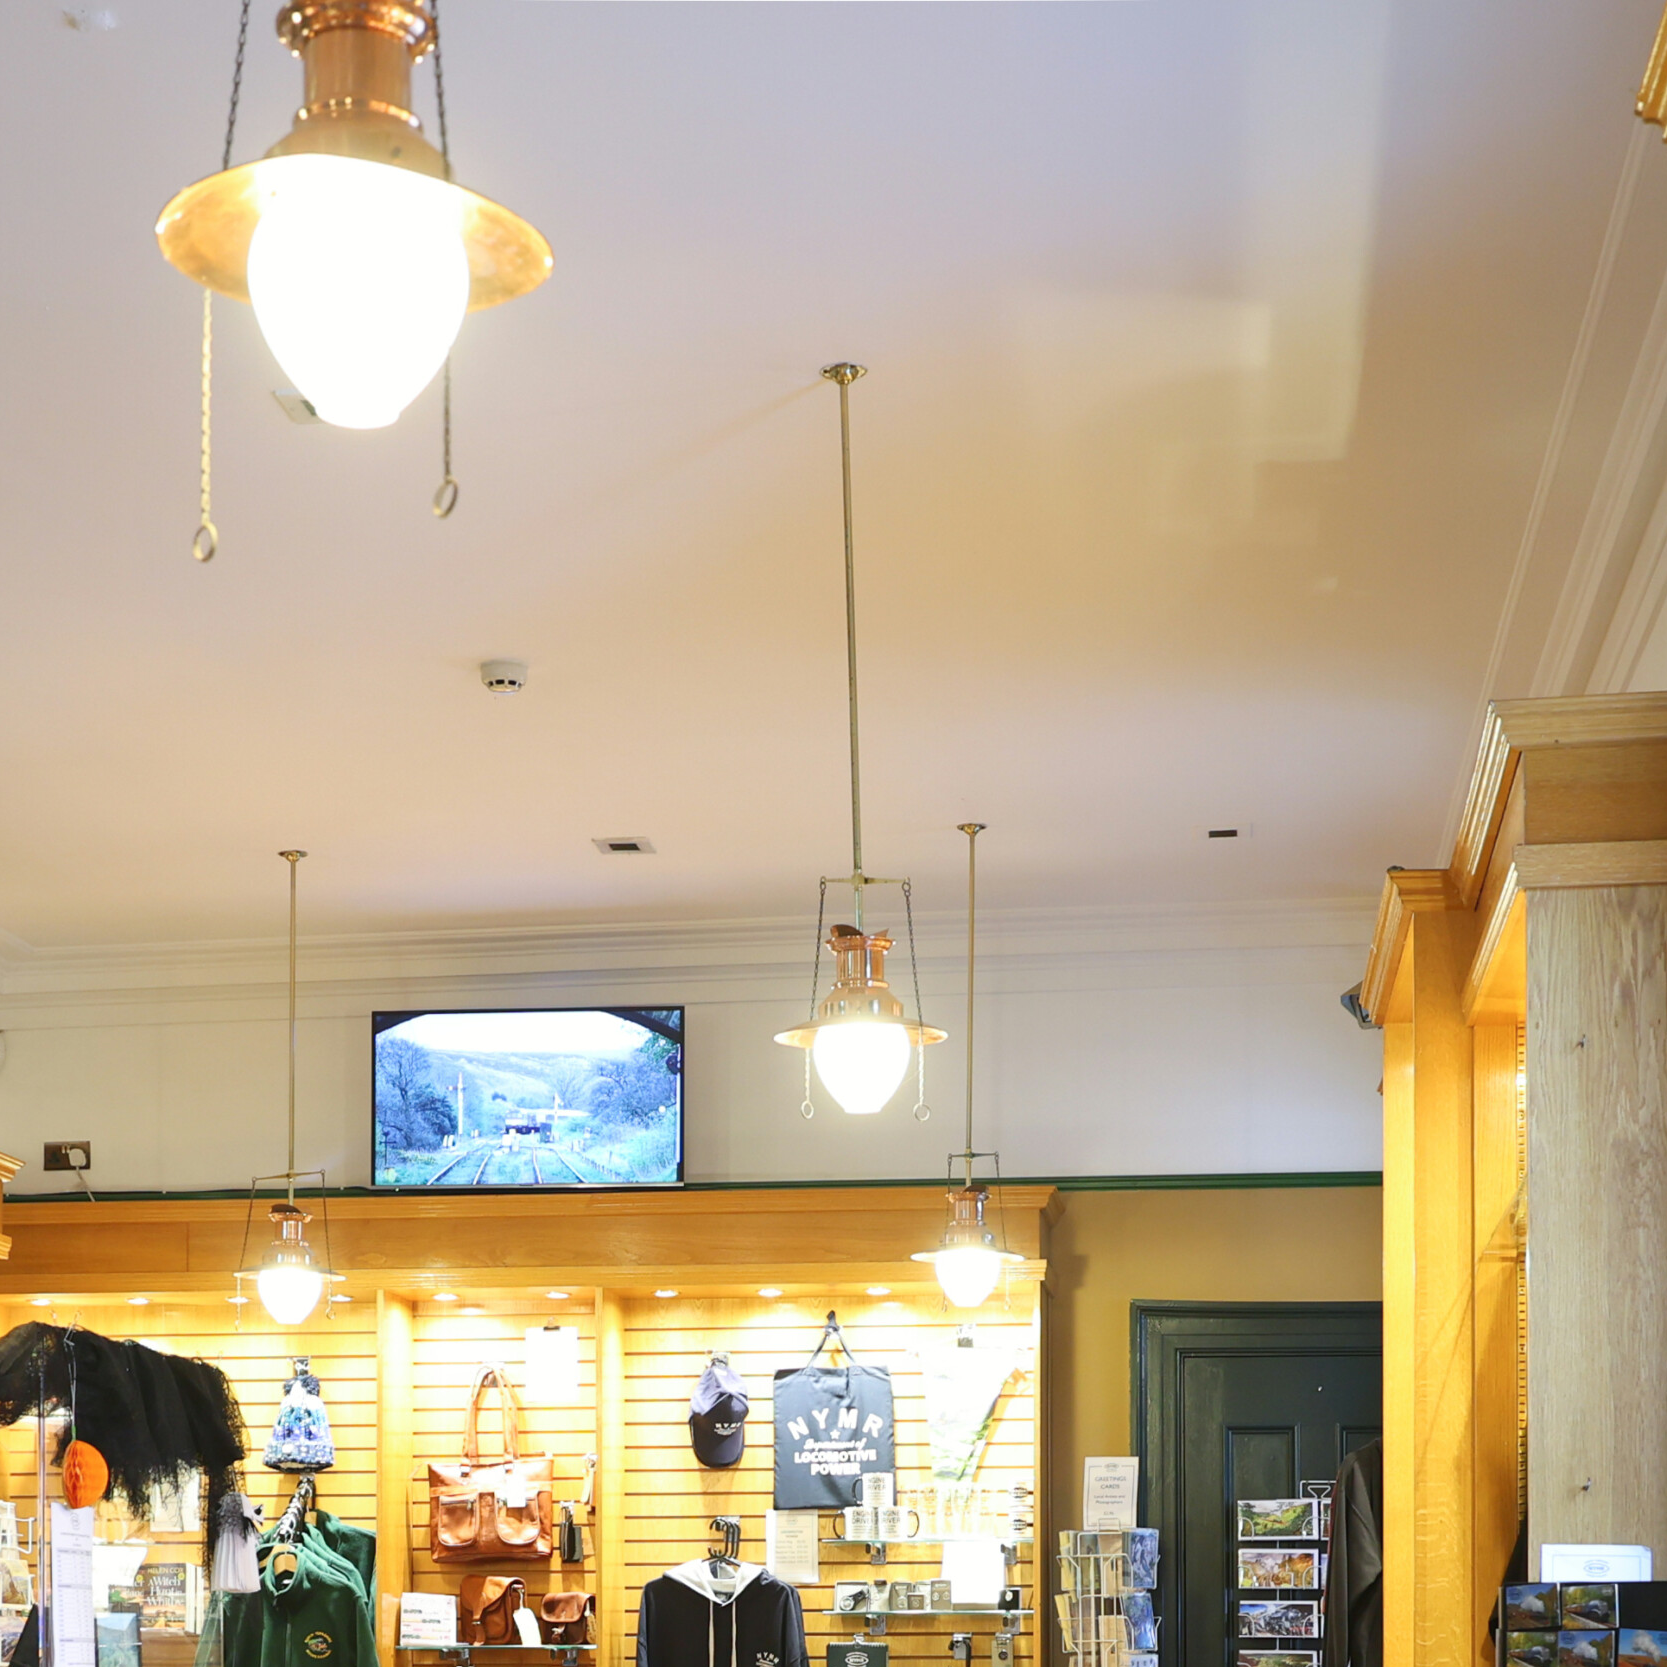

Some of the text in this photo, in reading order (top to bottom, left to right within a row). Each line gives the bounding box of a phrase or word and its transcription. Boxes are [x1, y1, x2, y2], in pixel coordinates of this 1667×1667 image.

[786, 1407, 884, 1441] NYMR
[794, 1449, 877, 1464] LOCOMOTIVE
[810, 1462, 861, 1476] POWER
[153, 1574, 182, 1587] Witch
